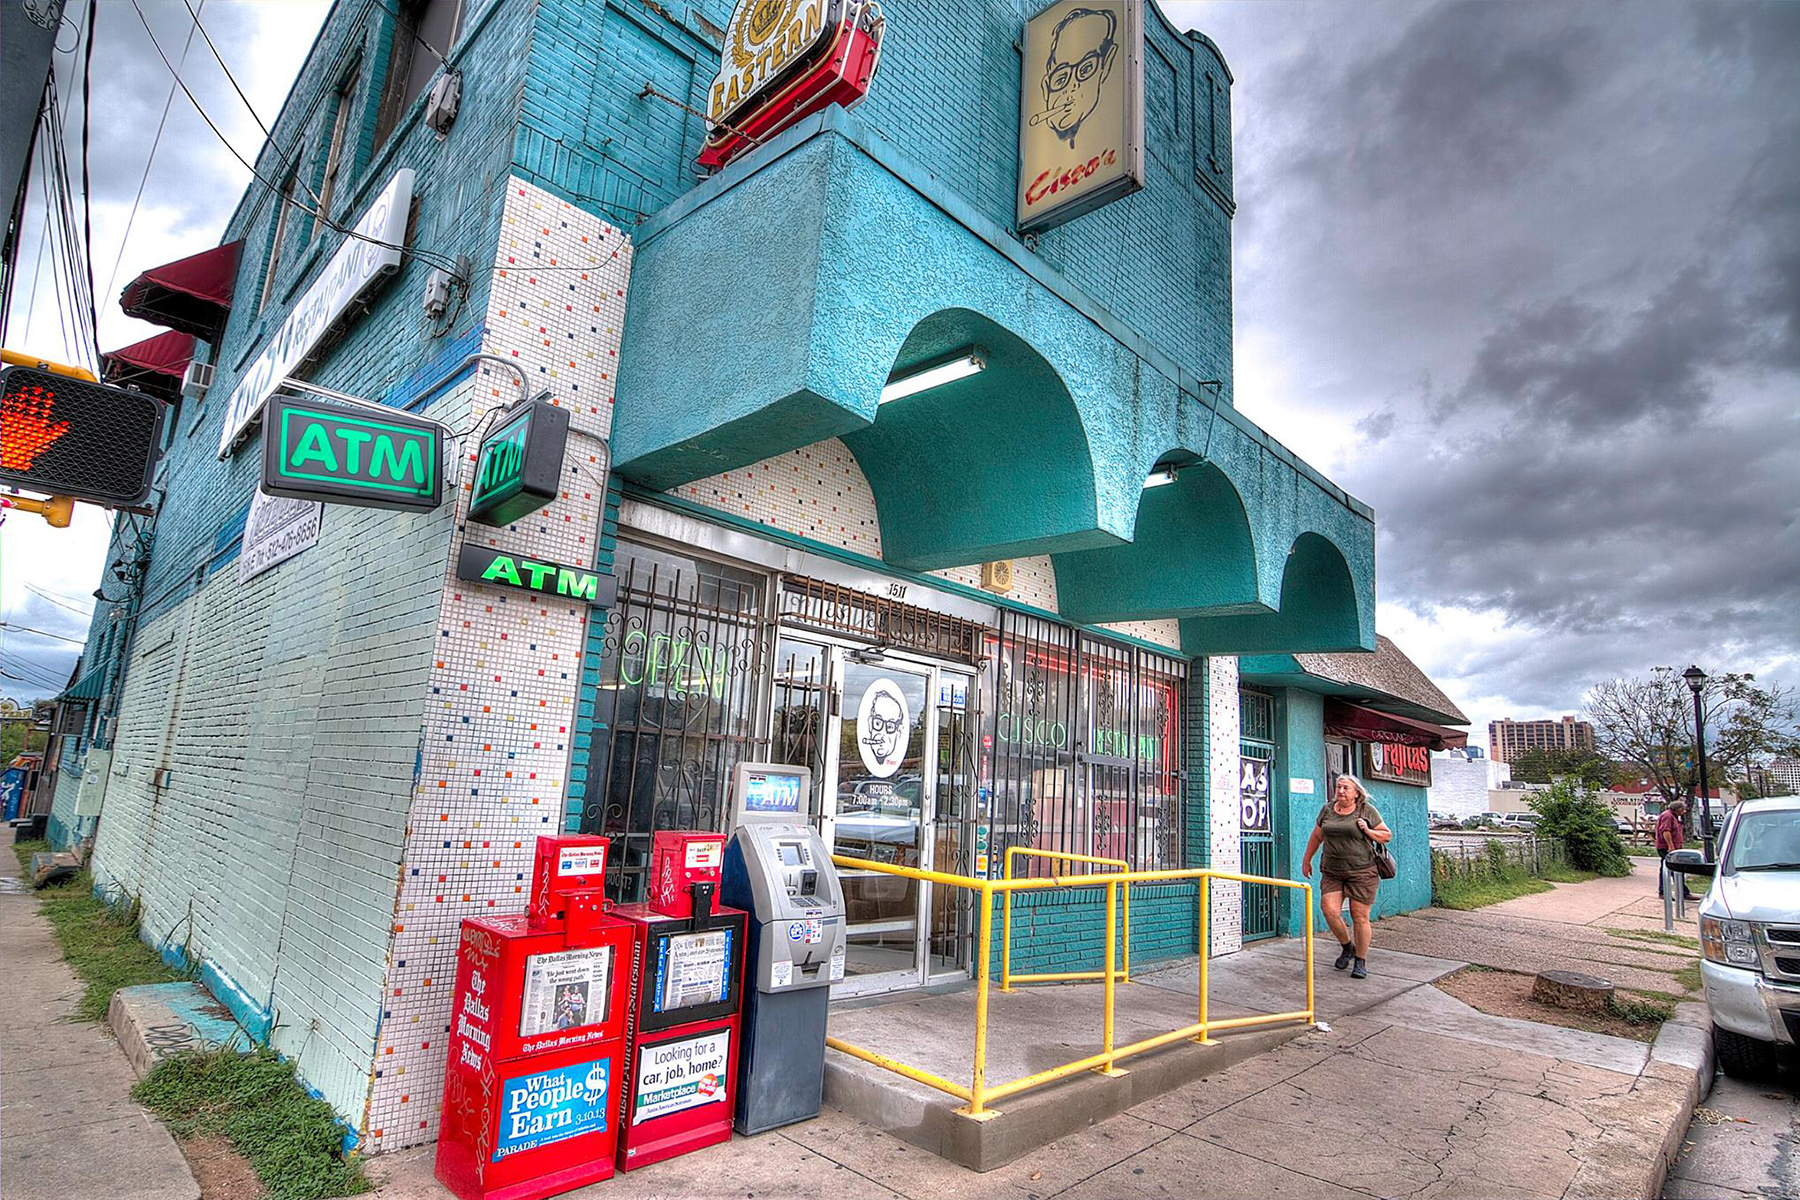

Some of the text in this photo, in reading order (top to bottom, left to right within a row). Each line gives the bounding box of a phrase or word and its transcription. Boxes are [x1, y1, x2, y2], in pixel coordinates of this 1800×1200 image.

[711, 0, 821, 119] EASTERN
[290, 422, 424, 485] ATM
[480, 427, 525, 490] ATM
[481, 555, 598, 600] ATM
[889, 583, 907, 599] 1511
[621, 630, 727, 698] OPEN
[999, 713, 1067, 748] CISCO
[1384, 742, 1428, 776] Fajitas
[761, 787, 799, 806] ATM
[852, 794, 878, 806] 7:00am
[869, 784, 893, 796] HOURS
[537, 951, 603, 965] The Dallas Morning News
[471, 970, 486, 997] The
[654, 969, 663, 1011] AUSTIN
[463, 991, 490, 1024] Dallas
[457, 1013, 491, 1053] Morning
[523, 1030, 604, 1053] The Dallas Morning News
[460, 1040, 483, 1073] News
[654, 1041, 716, 1066] Looking for a
[525, 1071, 565, 1093] What
[643, 1055, 724, 1085] car, job, home?
[508, 1078, 584, 1114] People
[618, 1080, 629, 1129] Austin
[643, 1084, 696, 1106] Marketplace
[508, 1107, 573, 1139] Earn
[575, 1107, 606, 1125] 3.10.13
[496, 1139, 538, 1158] PARADE
